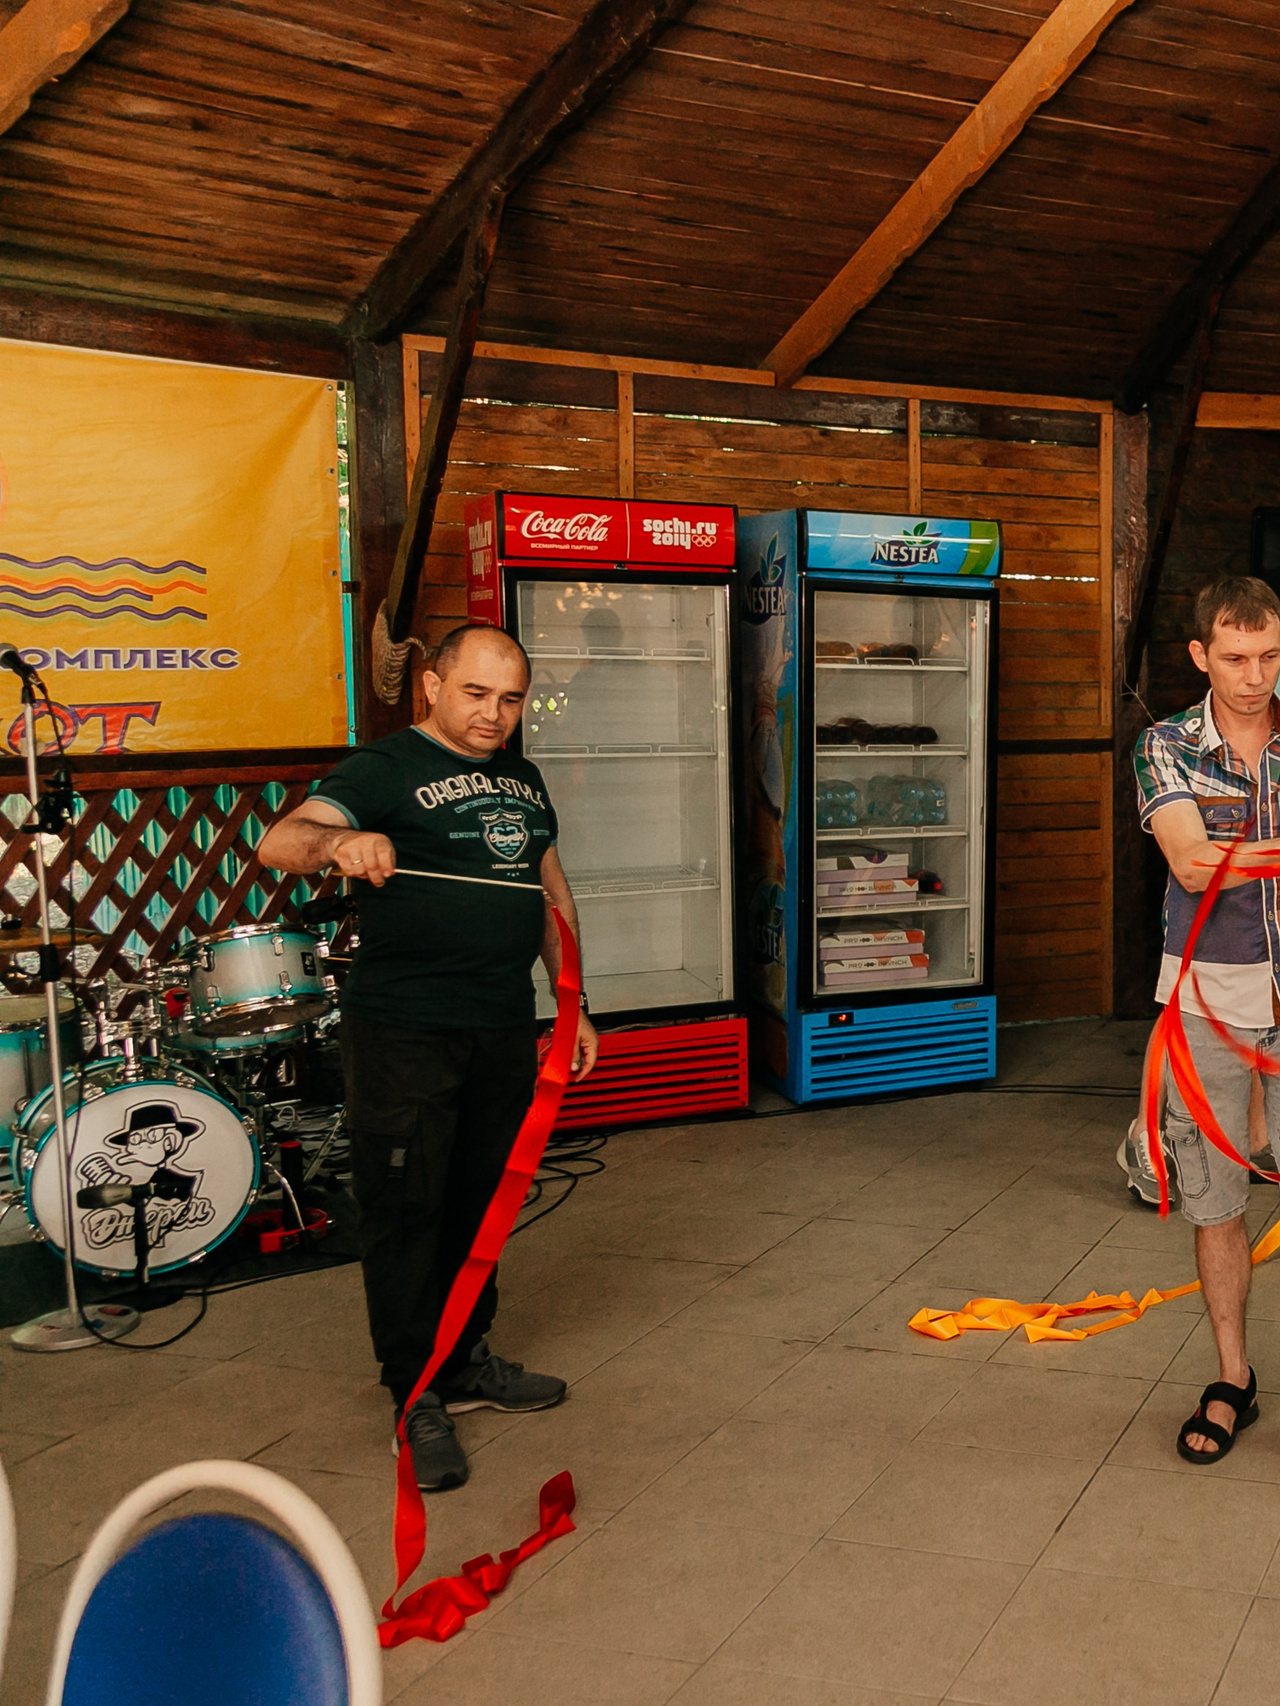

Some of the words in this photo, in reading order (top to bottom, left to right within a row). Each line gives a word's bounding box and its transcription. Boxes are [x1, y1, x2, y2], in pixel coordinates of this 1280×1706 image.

[521, 510, 613, 542] Coca-Cola
[643, 517, 717, 535] sochi.ru
[652, 532, 691, 550] 2014
[875, 542, 940, 564] NESTEA
[744, 584, 785, 614] NESTEA
[0, 646, 241, 671] ОМПЛЕКС
[0, 699, 161, 755] ОТ
[416, 772, 500, 809] ORIGINAL
[497, 777, 546, 810] STYLE
